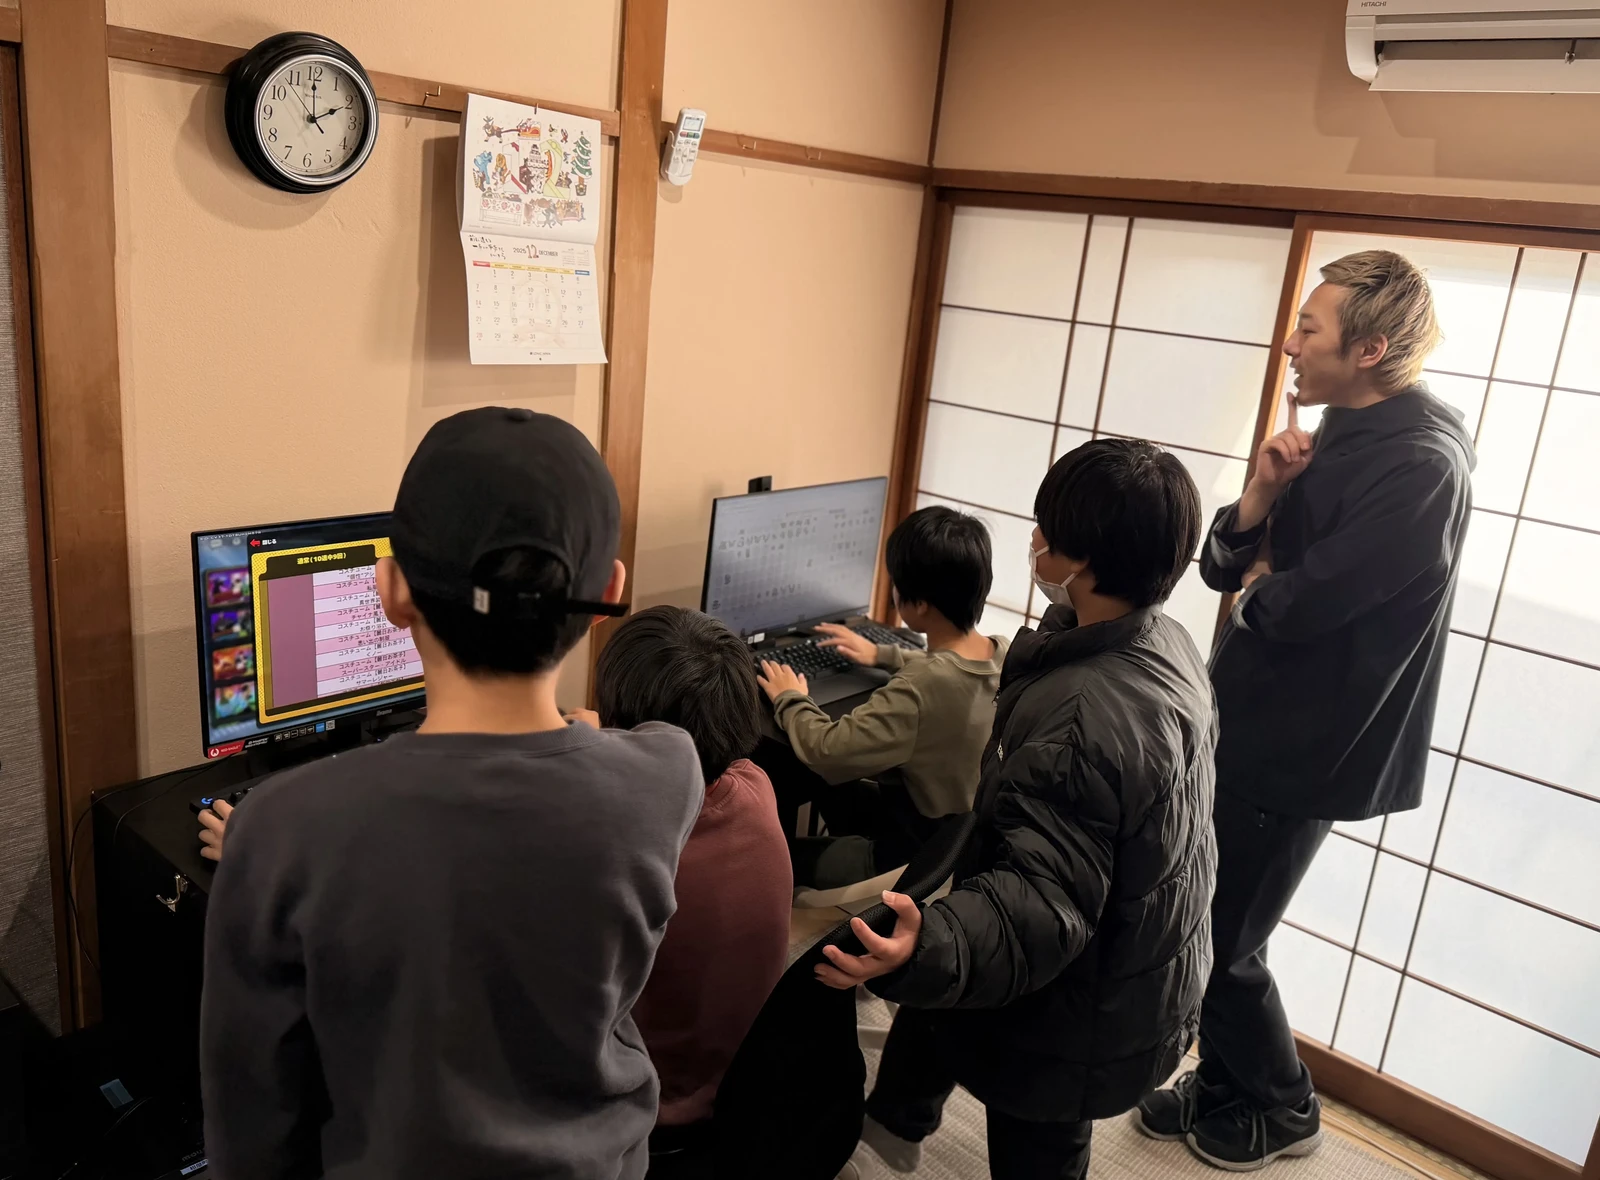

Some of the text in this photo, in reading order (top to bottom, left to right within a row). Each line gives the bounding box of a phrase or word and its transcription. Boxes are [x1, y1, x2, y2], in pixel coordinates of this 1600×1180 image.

[289, 70, 301, 86] 11
[307, 66, 323, 82] 12
[333, 77, 338, 91] 1
[271, 85, 286, 102] 10
[345, 95, 353, 110] 2
[263, 104, 273, 120] 9
[348, 116, 356, 130] 3
[268, 127, 277, 142] 8
[339, 136, 348, 150] 4
[284, 145, 293, 160] 7
[323, 149, 332, 164] 5
[303, 153, 312, 168] 6
[526, 244, 539, 259] 12
